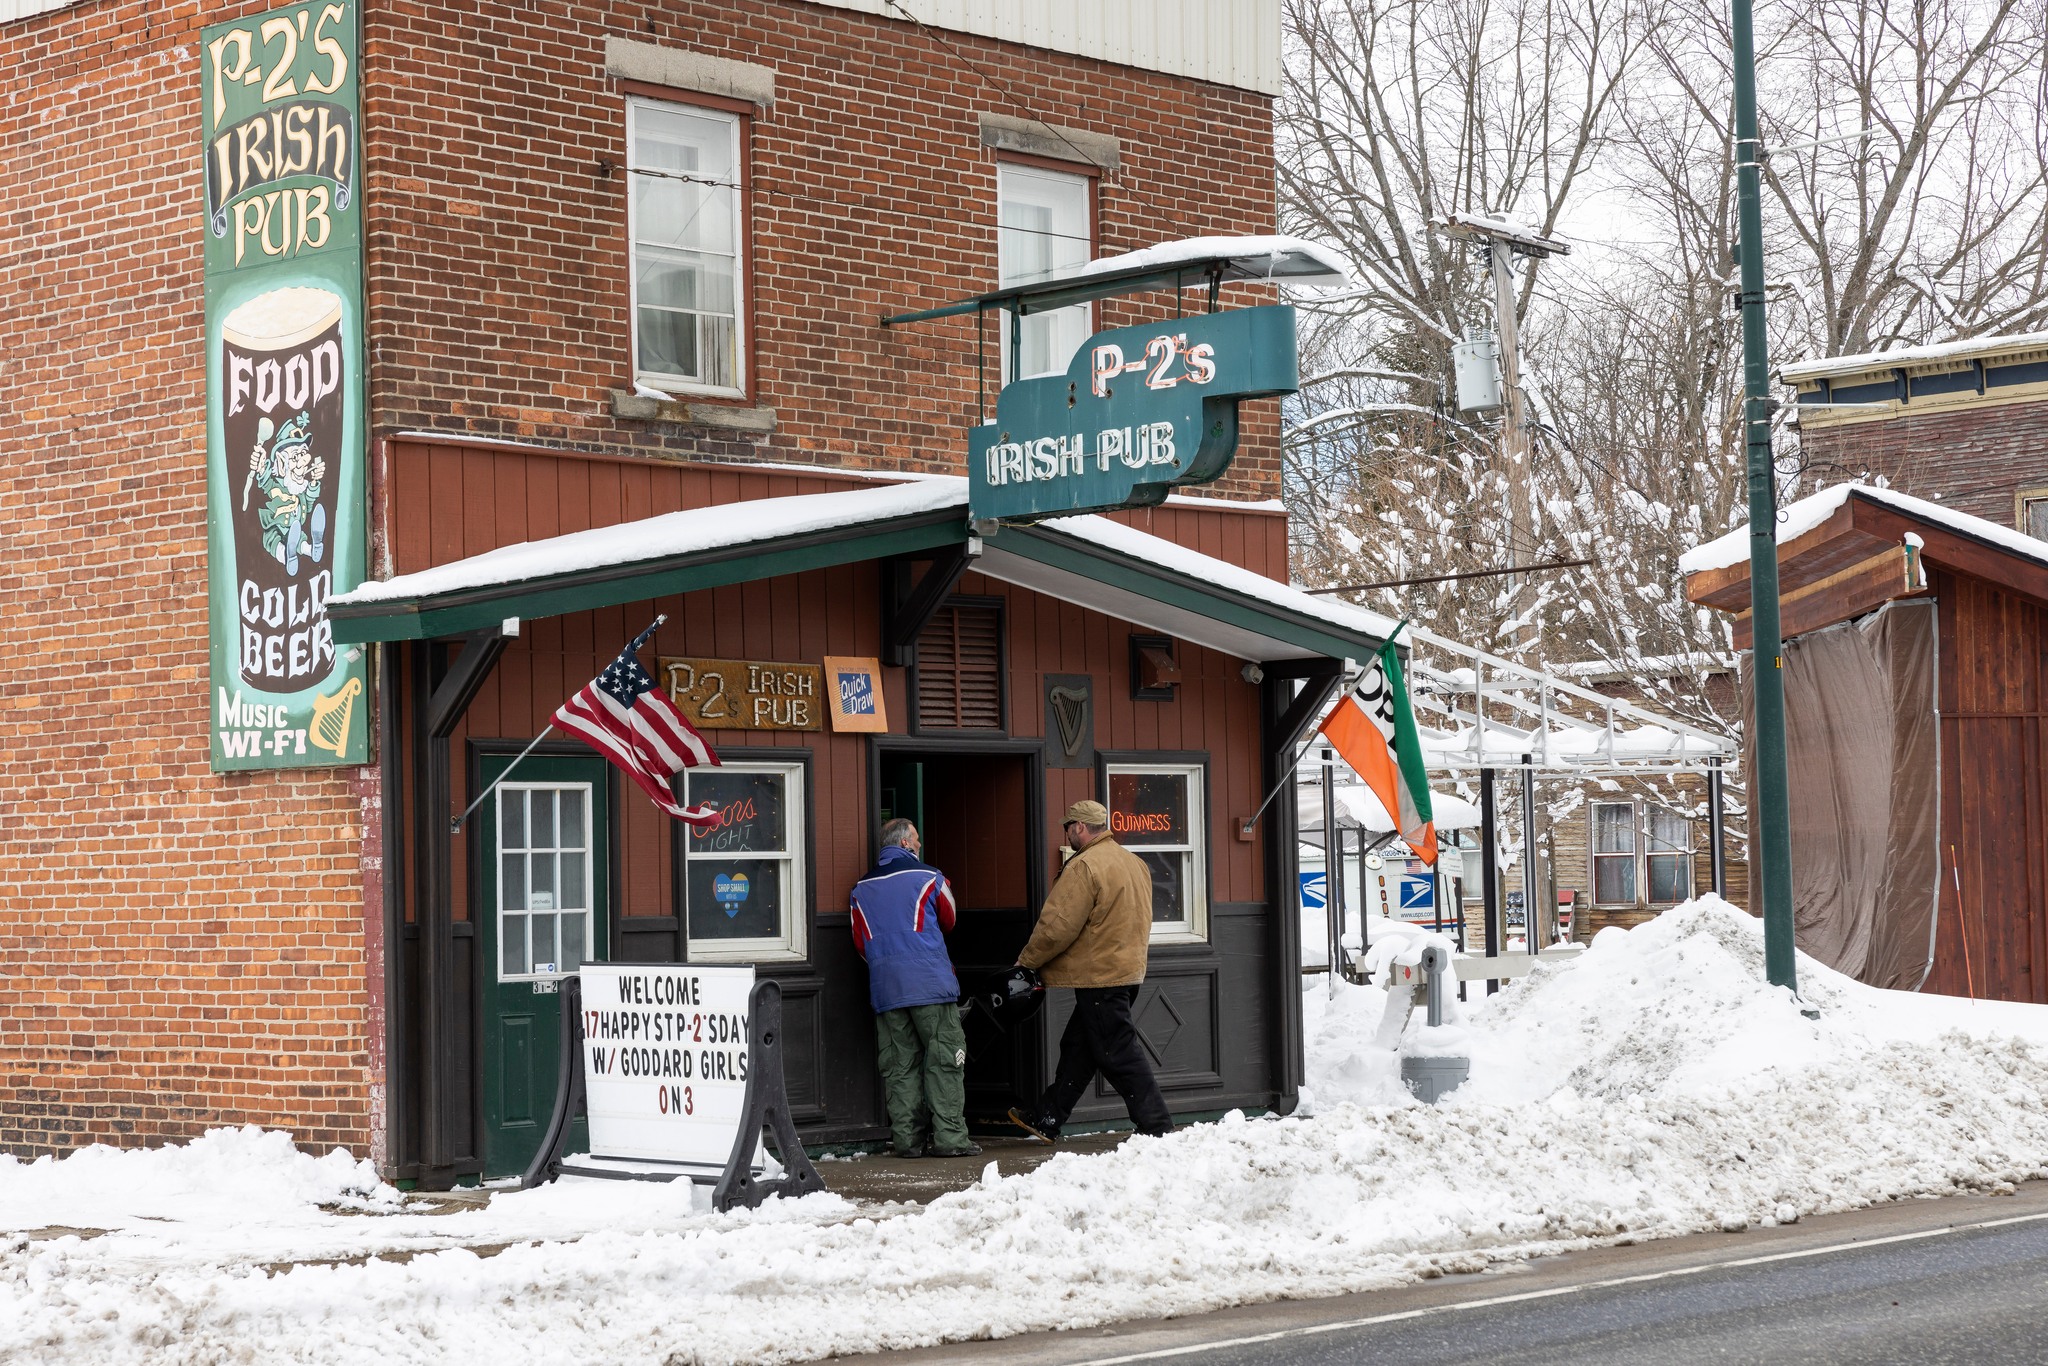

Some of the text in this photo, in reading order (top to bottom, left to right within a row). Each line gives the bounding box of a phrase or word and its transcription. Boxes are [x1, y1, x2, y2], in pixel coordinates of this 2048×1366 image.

[207, 2, 349, 133] P-2'S
[231, 184, 332, 269] PUB
[228, 339, 339, 418] FOOD
[986, 421, 1176, 487] IRISH PUB
[240, 569, 332, 629] COLD
[241, 618, 336, 680] BEER
[840, 672, 867, 700] Quick
[754, 697, 809, 726] PUB
[851, 691, 874, 715] Draw
[219, 729, 307, 759] WI-FI
[1111, 811, 1171, 832] GUINNESS
[1400, 911, 1434, 919] www.usps.com
[619, 975, 701, 1006] WELCOME
[621, 1047, 692, 1078] GODDARD
[701, 1050, 748, 1082] GIRLS
